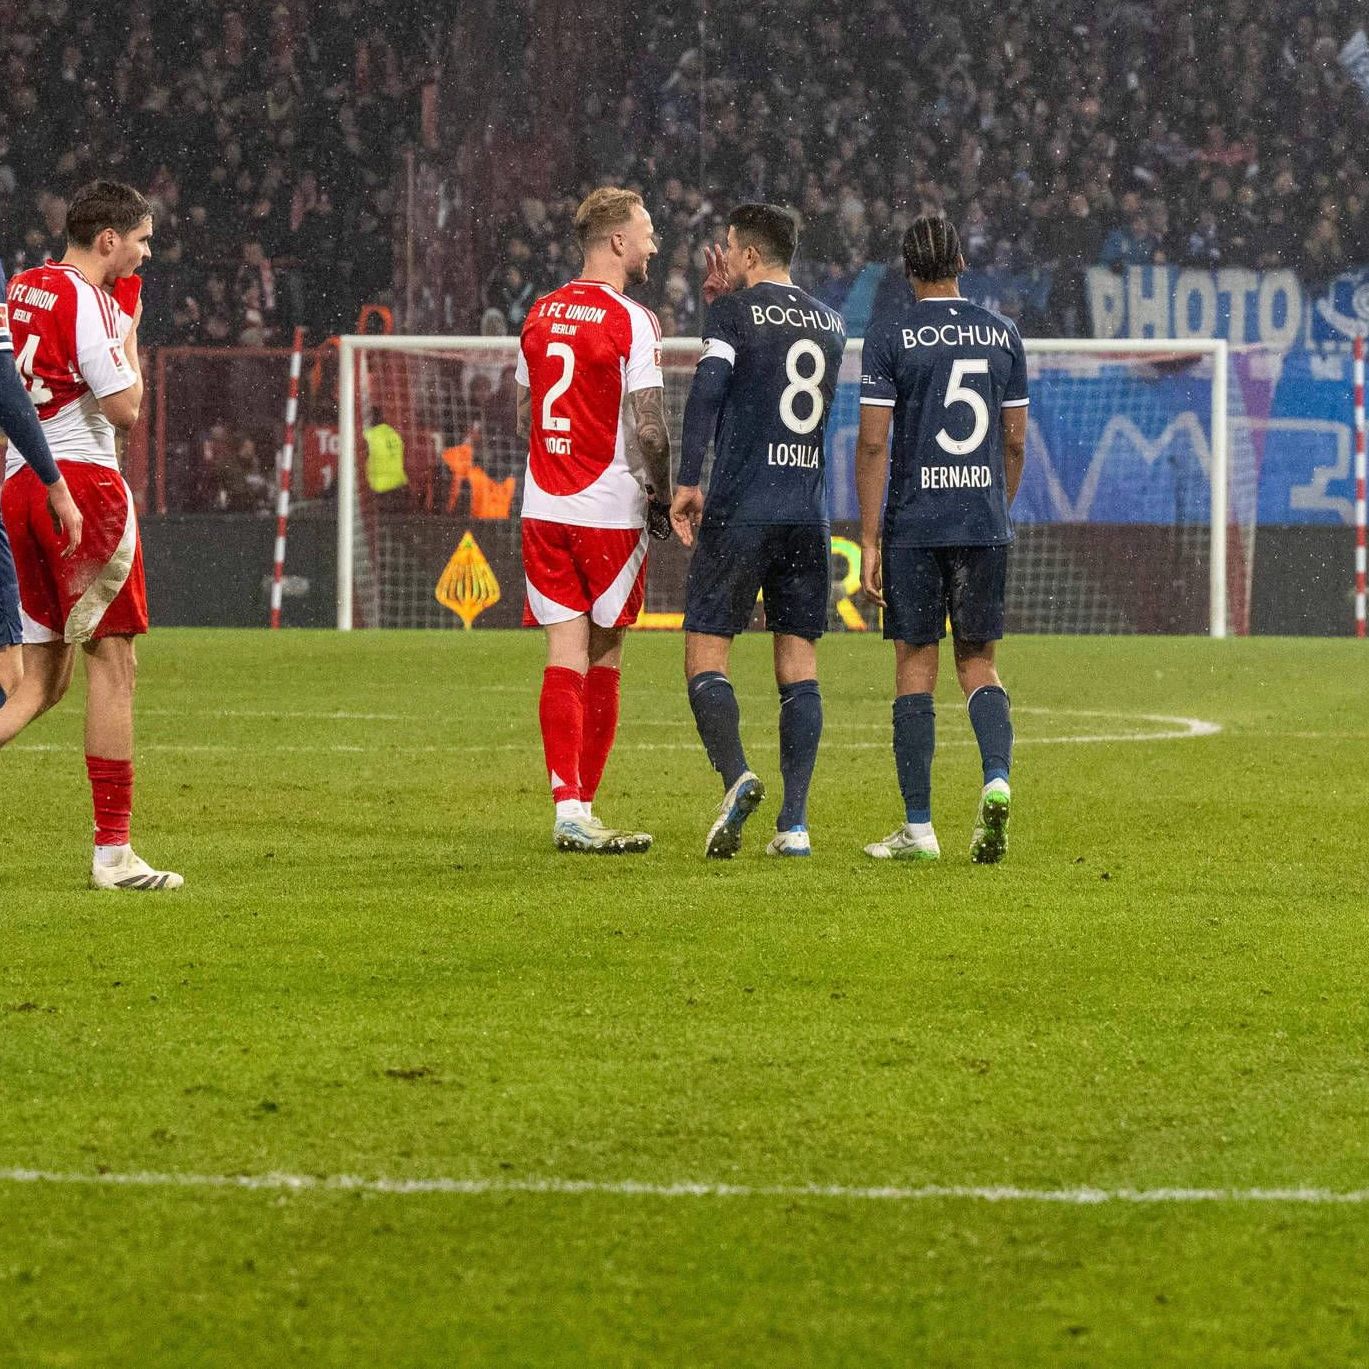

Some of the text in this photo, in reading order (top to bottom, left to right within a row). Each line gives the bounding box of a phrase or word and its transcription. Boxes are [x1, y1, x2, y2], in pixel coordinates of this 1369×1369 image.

[27, 286, 59, 312] UNION
[546, 302, 567, 319] FC
[565, 305, 607, 325] UNION
[1086, 265, 1303, 347] PHOTO
[550, 323, 578, 336] BERLIN
[750, 305, 846, 336] BOCHUM
[901, 324, 1011, 350] BOCHUM
[542, 341, 576, 432] 2
[778, 338, 826, 436] 8
[934, 358, 990, 456] 5
[767, 443, 820, 470] LOSILLA
